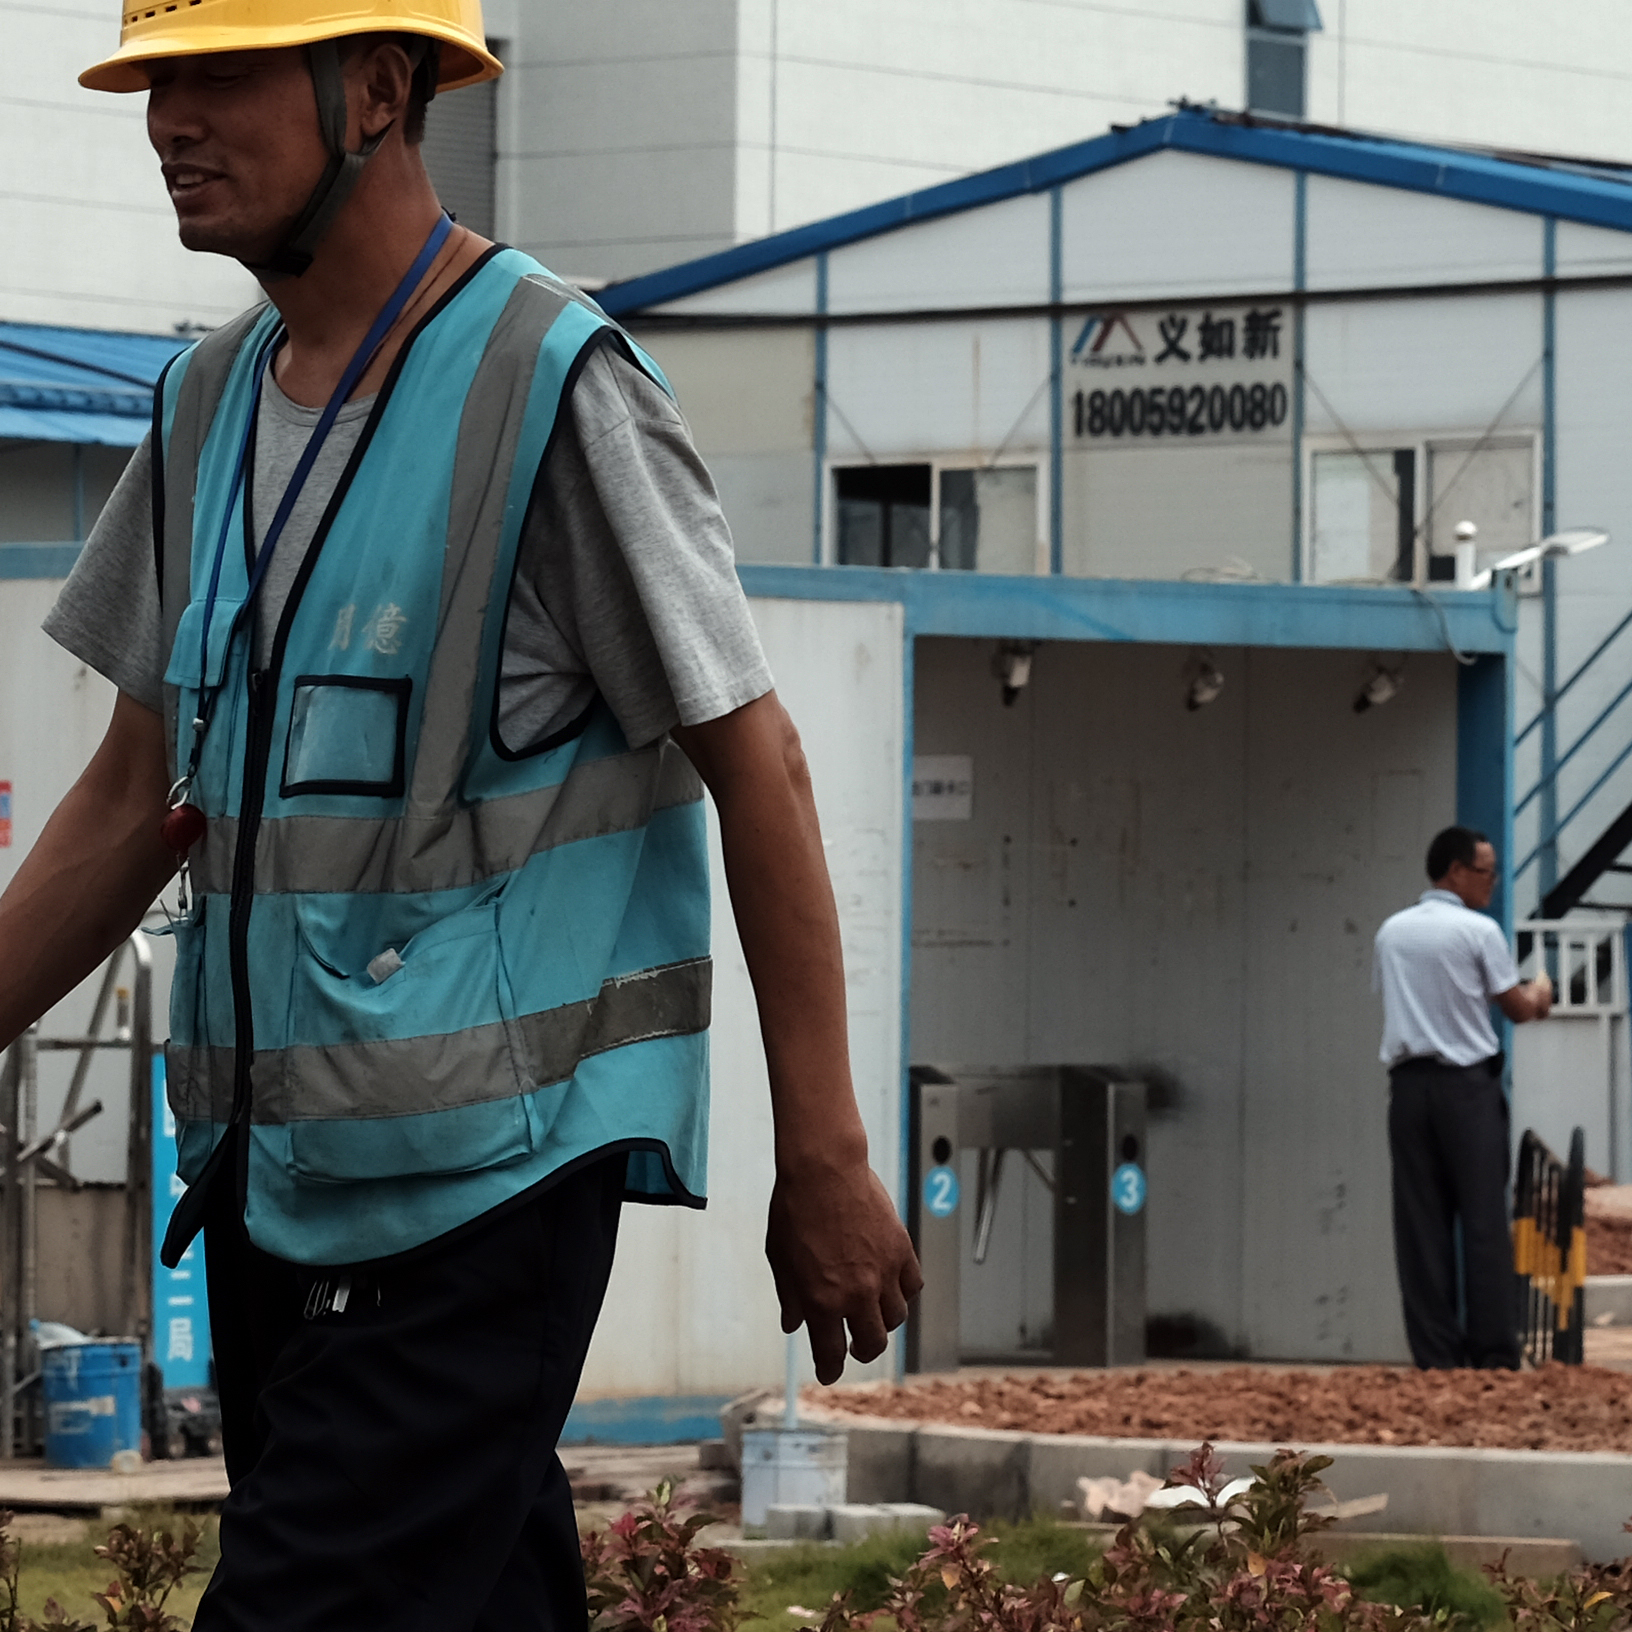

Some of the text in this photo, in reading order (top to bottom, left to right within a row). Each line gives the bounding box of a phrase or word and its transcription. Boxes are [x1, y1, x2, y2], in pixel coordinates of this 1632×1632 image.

[1073, 381, 1288, 438] 18005920080
[931, 1170, 953, 1211] 2
[1118, 1169, 1140, 1208] 3
